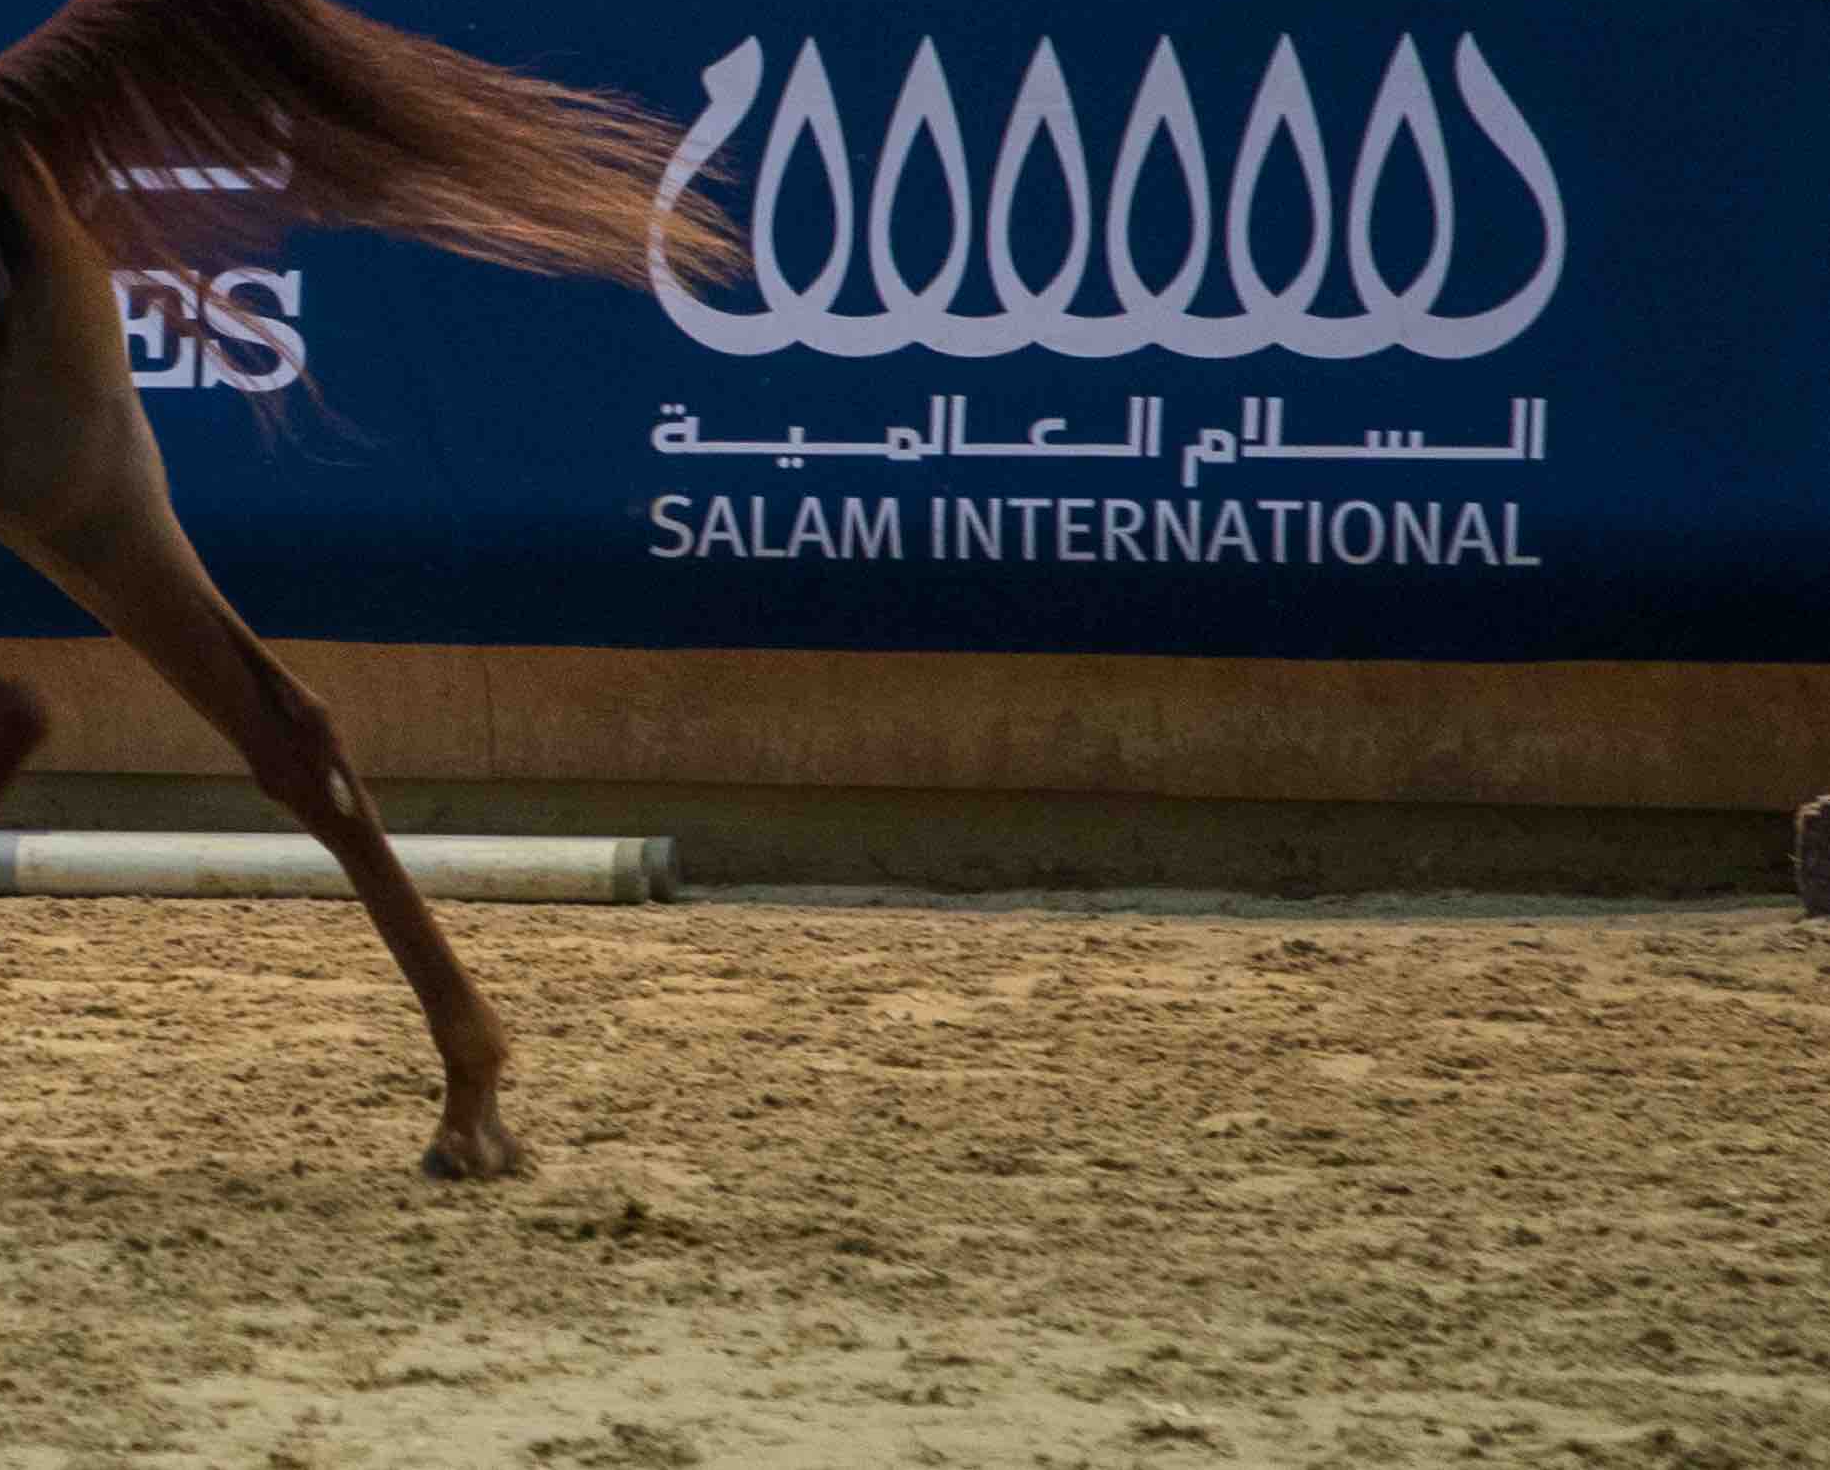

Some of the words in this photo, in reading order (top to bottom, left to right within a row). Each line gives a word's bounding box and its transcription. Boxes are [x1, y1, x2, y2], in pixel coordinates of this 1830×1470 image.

[650, 394, 1164, 470] العالمية
[1180, 396, 1548, 489] السلام
[648, 494, 904, 560] SALAM
[930, 496, 1542, 567] INTERNATIONAL
